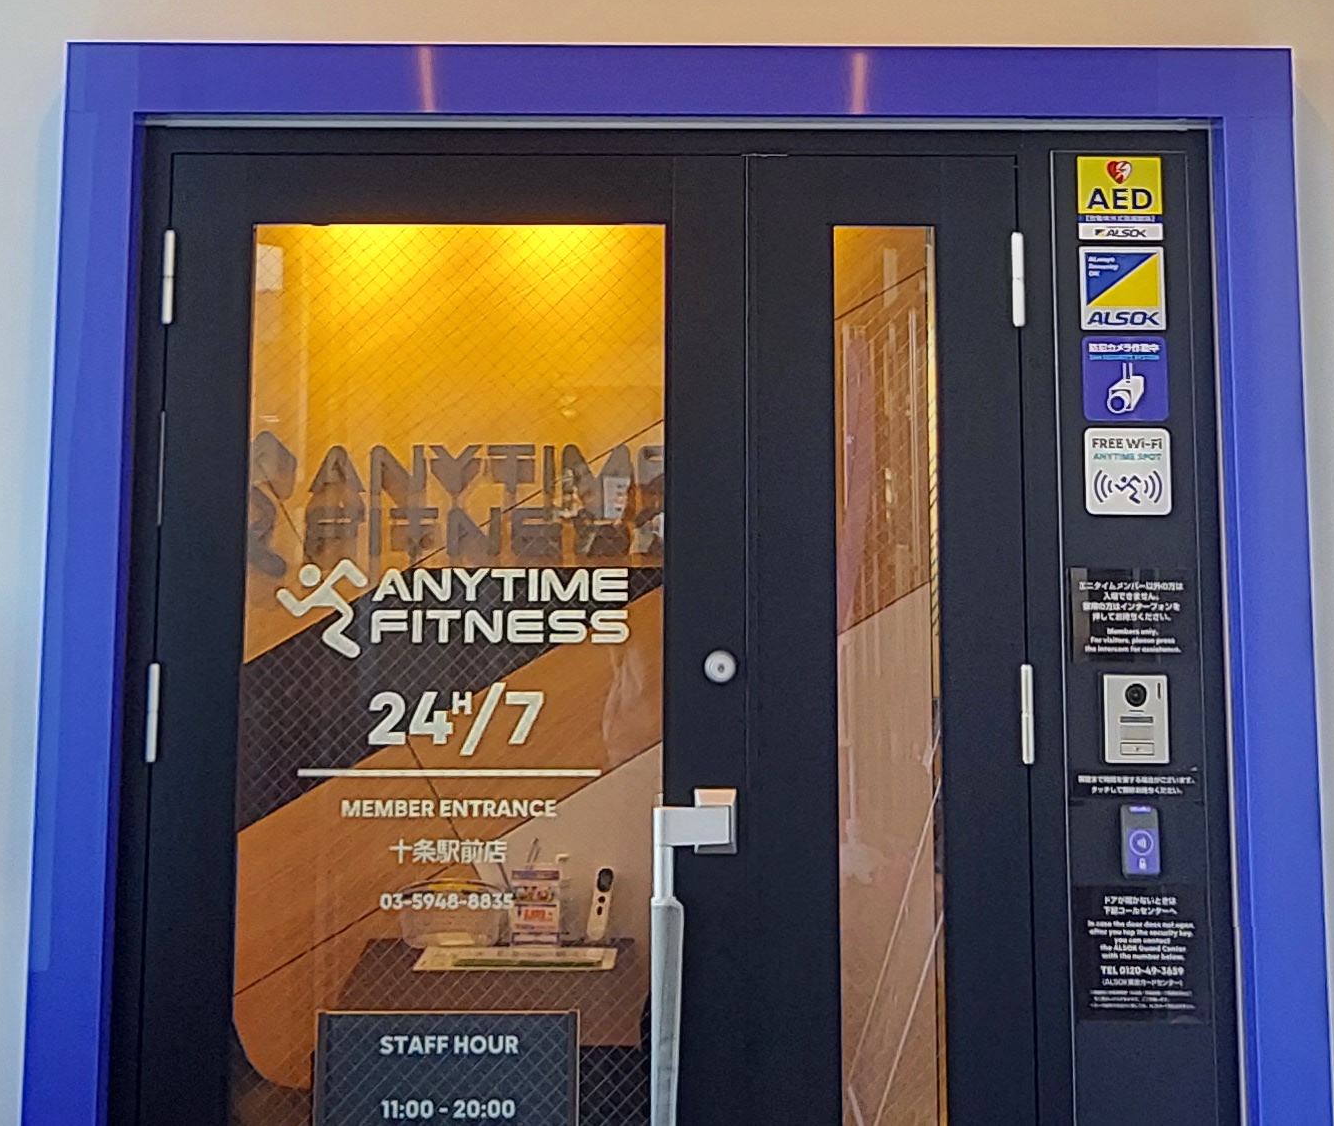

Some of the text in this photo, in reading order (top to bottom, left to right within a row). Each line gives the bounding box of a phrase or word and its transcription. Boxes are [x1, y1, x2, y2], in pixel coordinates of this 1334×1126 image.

[1086, 187, 1153, 210] AED
[1107, 229, 1147, 238] ALSOK
[1087, 311, 1160, 326] ALSOK
[1091, 438, 1163, 450] FREE Wi-Fi
[1093, 452, 1162, 461] ANYTIME SPOT
[372, 567, 629, 602] ANYTIME
[370, 609, 630, 644] FITNESS
[341, 799, 558, 818] MEMBER ENTRANCE
[389, 839, 508, 864] 十条駅前店
[379, 892, 515, 911] 03-5948-8835
[1100, 965, 1118, 975] TEL
[379, 1035, 519, 1055] STAFF HOUR
[380, 1099, 434, 1119] 11:00
[452, 1099, 517, 1119] 20:00
